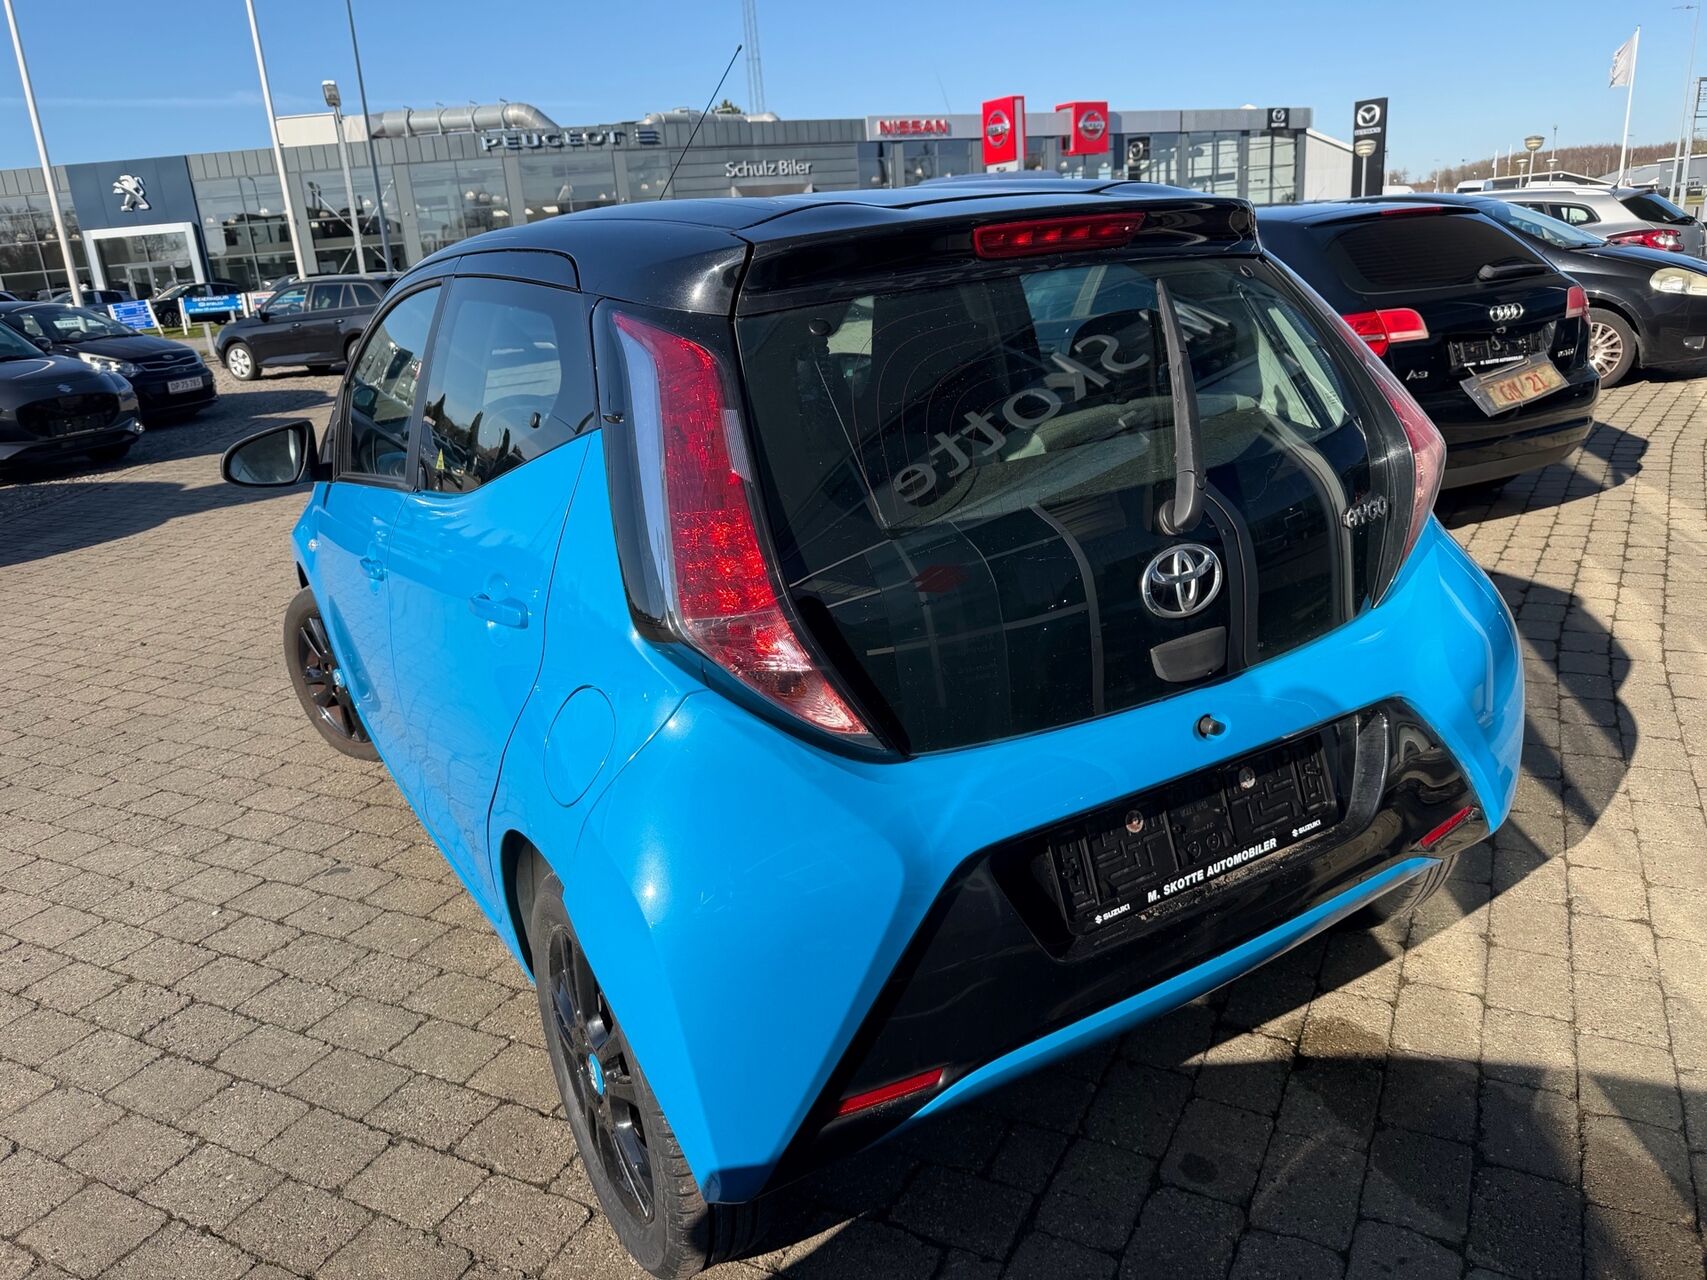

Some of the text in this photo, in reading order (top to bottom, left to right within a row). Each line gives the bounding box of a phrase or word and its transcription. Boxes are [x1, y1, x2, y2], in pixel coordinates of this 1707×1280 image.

[878, 119, 948, 136] NISSAN
[480, 129, 626, 151] PEUGEOT
[725, 159, 812, 178] Schulz Biler
[1405, 369, 1429, 381] A3
[1525, 373, 1550, 393] 21
[1342, 496, 1387, 529] AYGO
[1298, 819, 1321, 834] SUZUKI
[1147, 837, 1278, 903] M. SKOTTE AUTOMOBILER
[1102, 903, 1131, 921] SUZUKI
